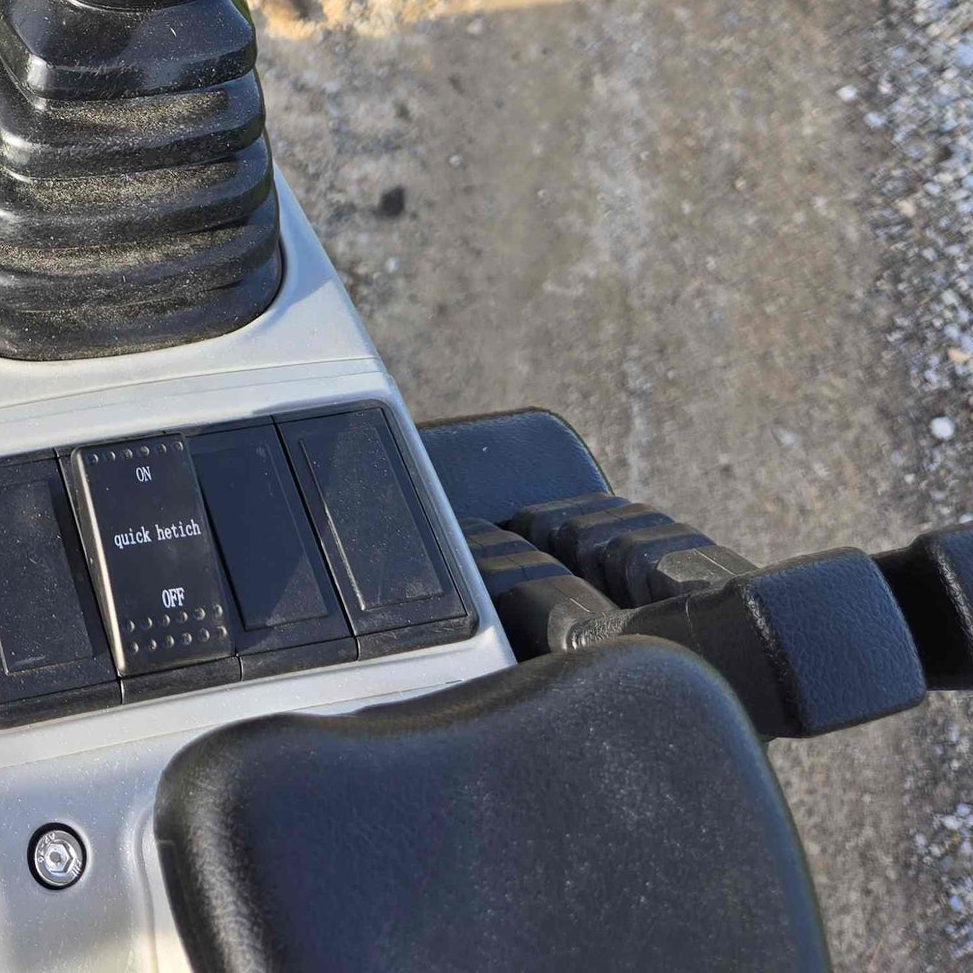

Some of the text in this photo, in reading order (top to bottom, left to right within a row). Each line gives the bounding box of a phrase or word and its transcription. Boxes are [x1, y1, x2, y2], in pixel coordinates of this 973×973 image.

[136, 466, 151, 482] ON
[114, 519, 201, 549] quick hetich
[162, 587, 185, 608] OFF
